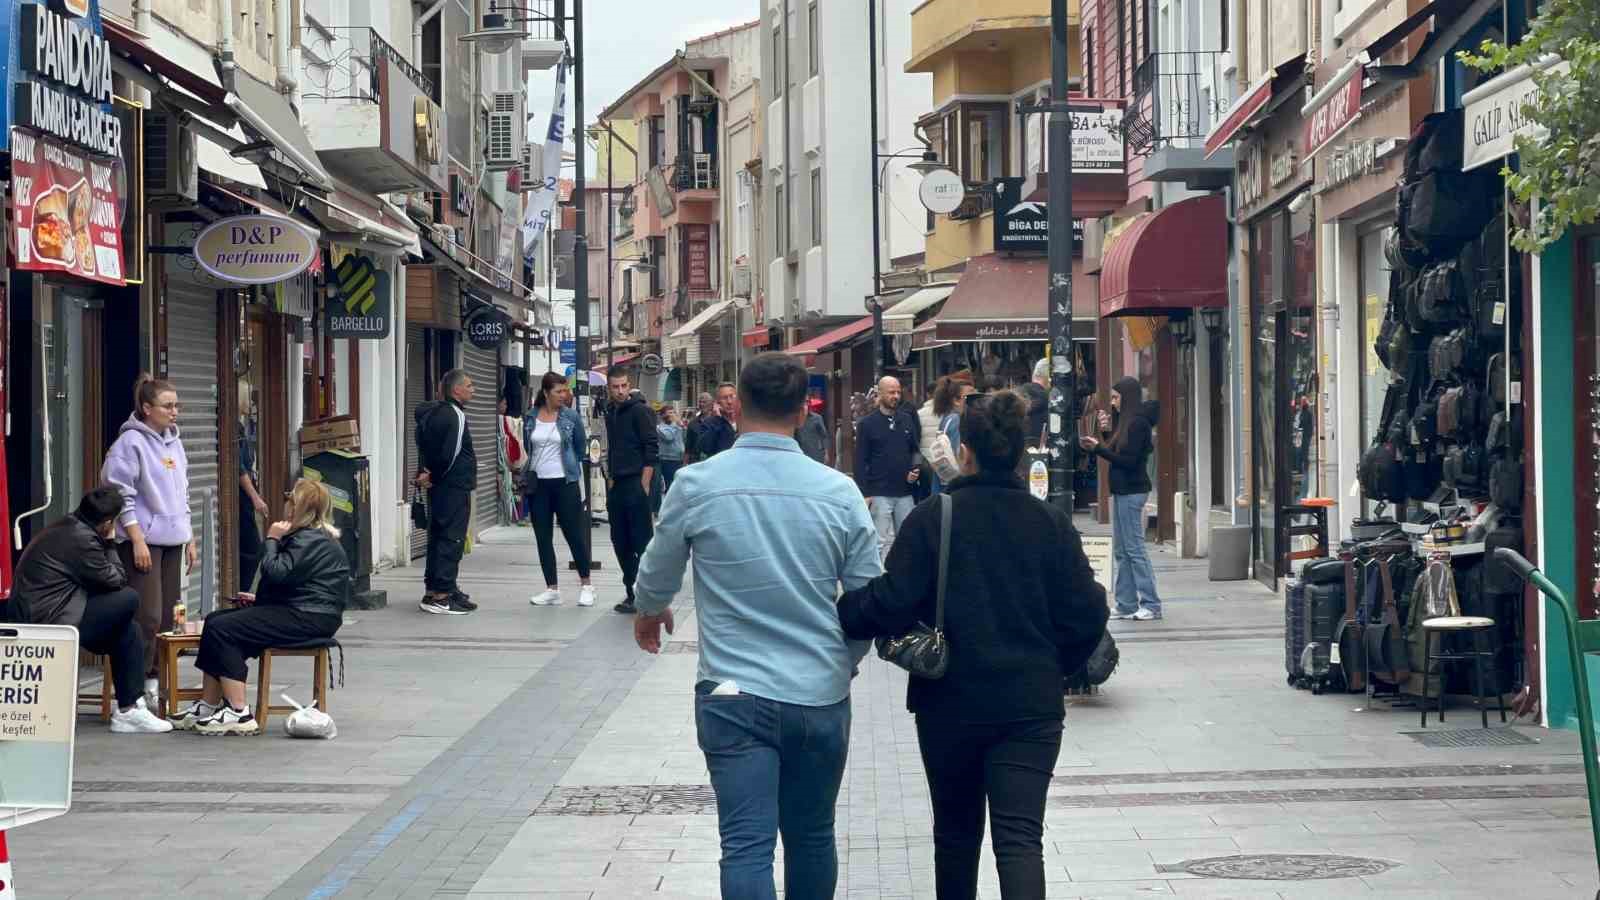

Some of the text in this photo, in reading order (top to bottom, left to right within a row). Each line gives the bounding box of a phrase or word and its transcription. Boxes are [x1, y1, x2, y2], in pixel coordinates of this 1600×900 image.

[36, 3, 114, 105] PANDORA
[1473, 101, 1502, 146] GALİP
[1008, 219, 1033, 231] BİGA
[1033, 220, 1049, 231] DE
[231, 226, 281, 245] D&P
[215, 248, 301, 268] perfumum
[330, 316, 384, 331] BARGELLO
[471, 322, 503, 335] LORIS
[4, 645, 56, 659] UYGUN
[0, 660, 43, 682] FÜM
[9, 710, 32, 721] özel
